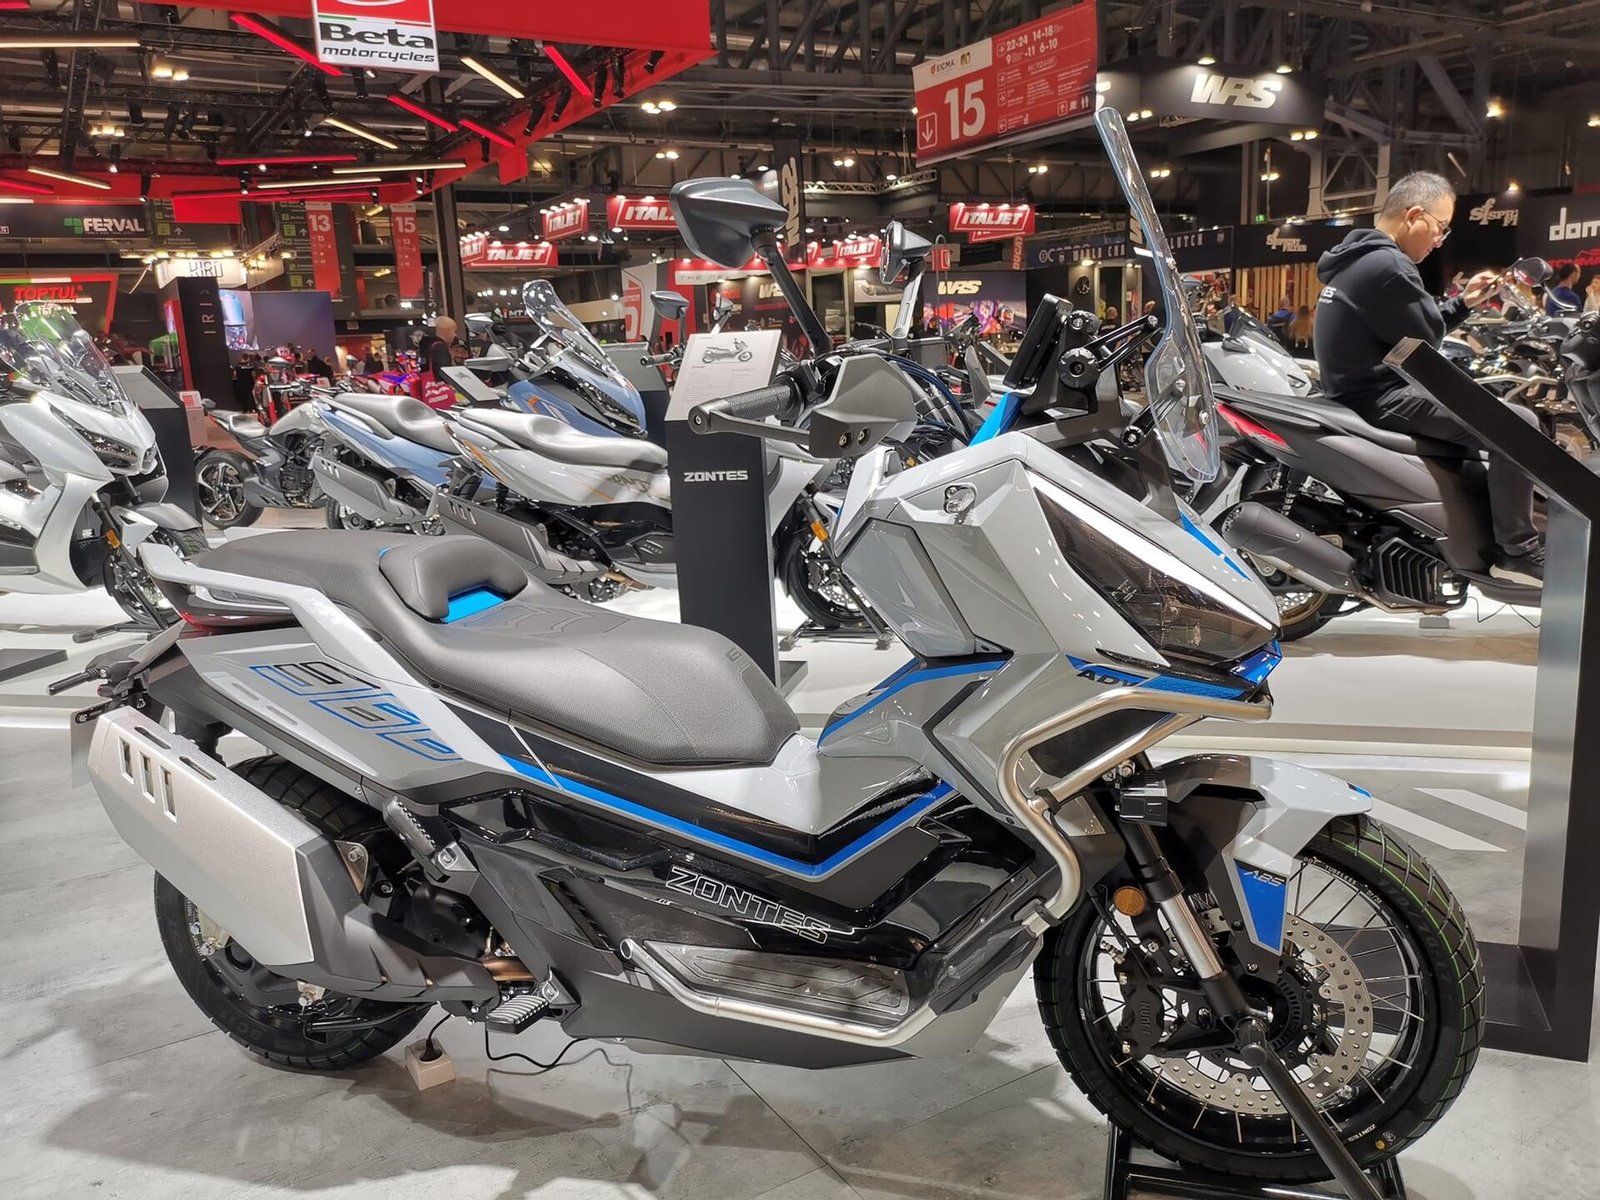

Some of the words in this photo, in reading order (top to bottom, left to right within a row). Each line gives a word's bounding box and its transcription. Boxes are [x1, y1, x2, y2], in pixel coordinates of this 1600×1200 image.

[319, 22, 434, 49] Beta
[322, 47, 434, 62] motorcycles
[1191, 72, 1283, 109] WRS
[944, 79, 986, 140] 15
[83, 217, 145, 232] FERVAL
[308, 214, 331, 232] 13
[395, 216, 416, 234] 15
[961, 211, 1022, 226] ITALJET
[938, 280, 982, 295] WRS
[683, 470, 749, 483] ZONTES
[1243, 870, 1285, 888] ABS
[666, 866, 831, 944] ZONTES
